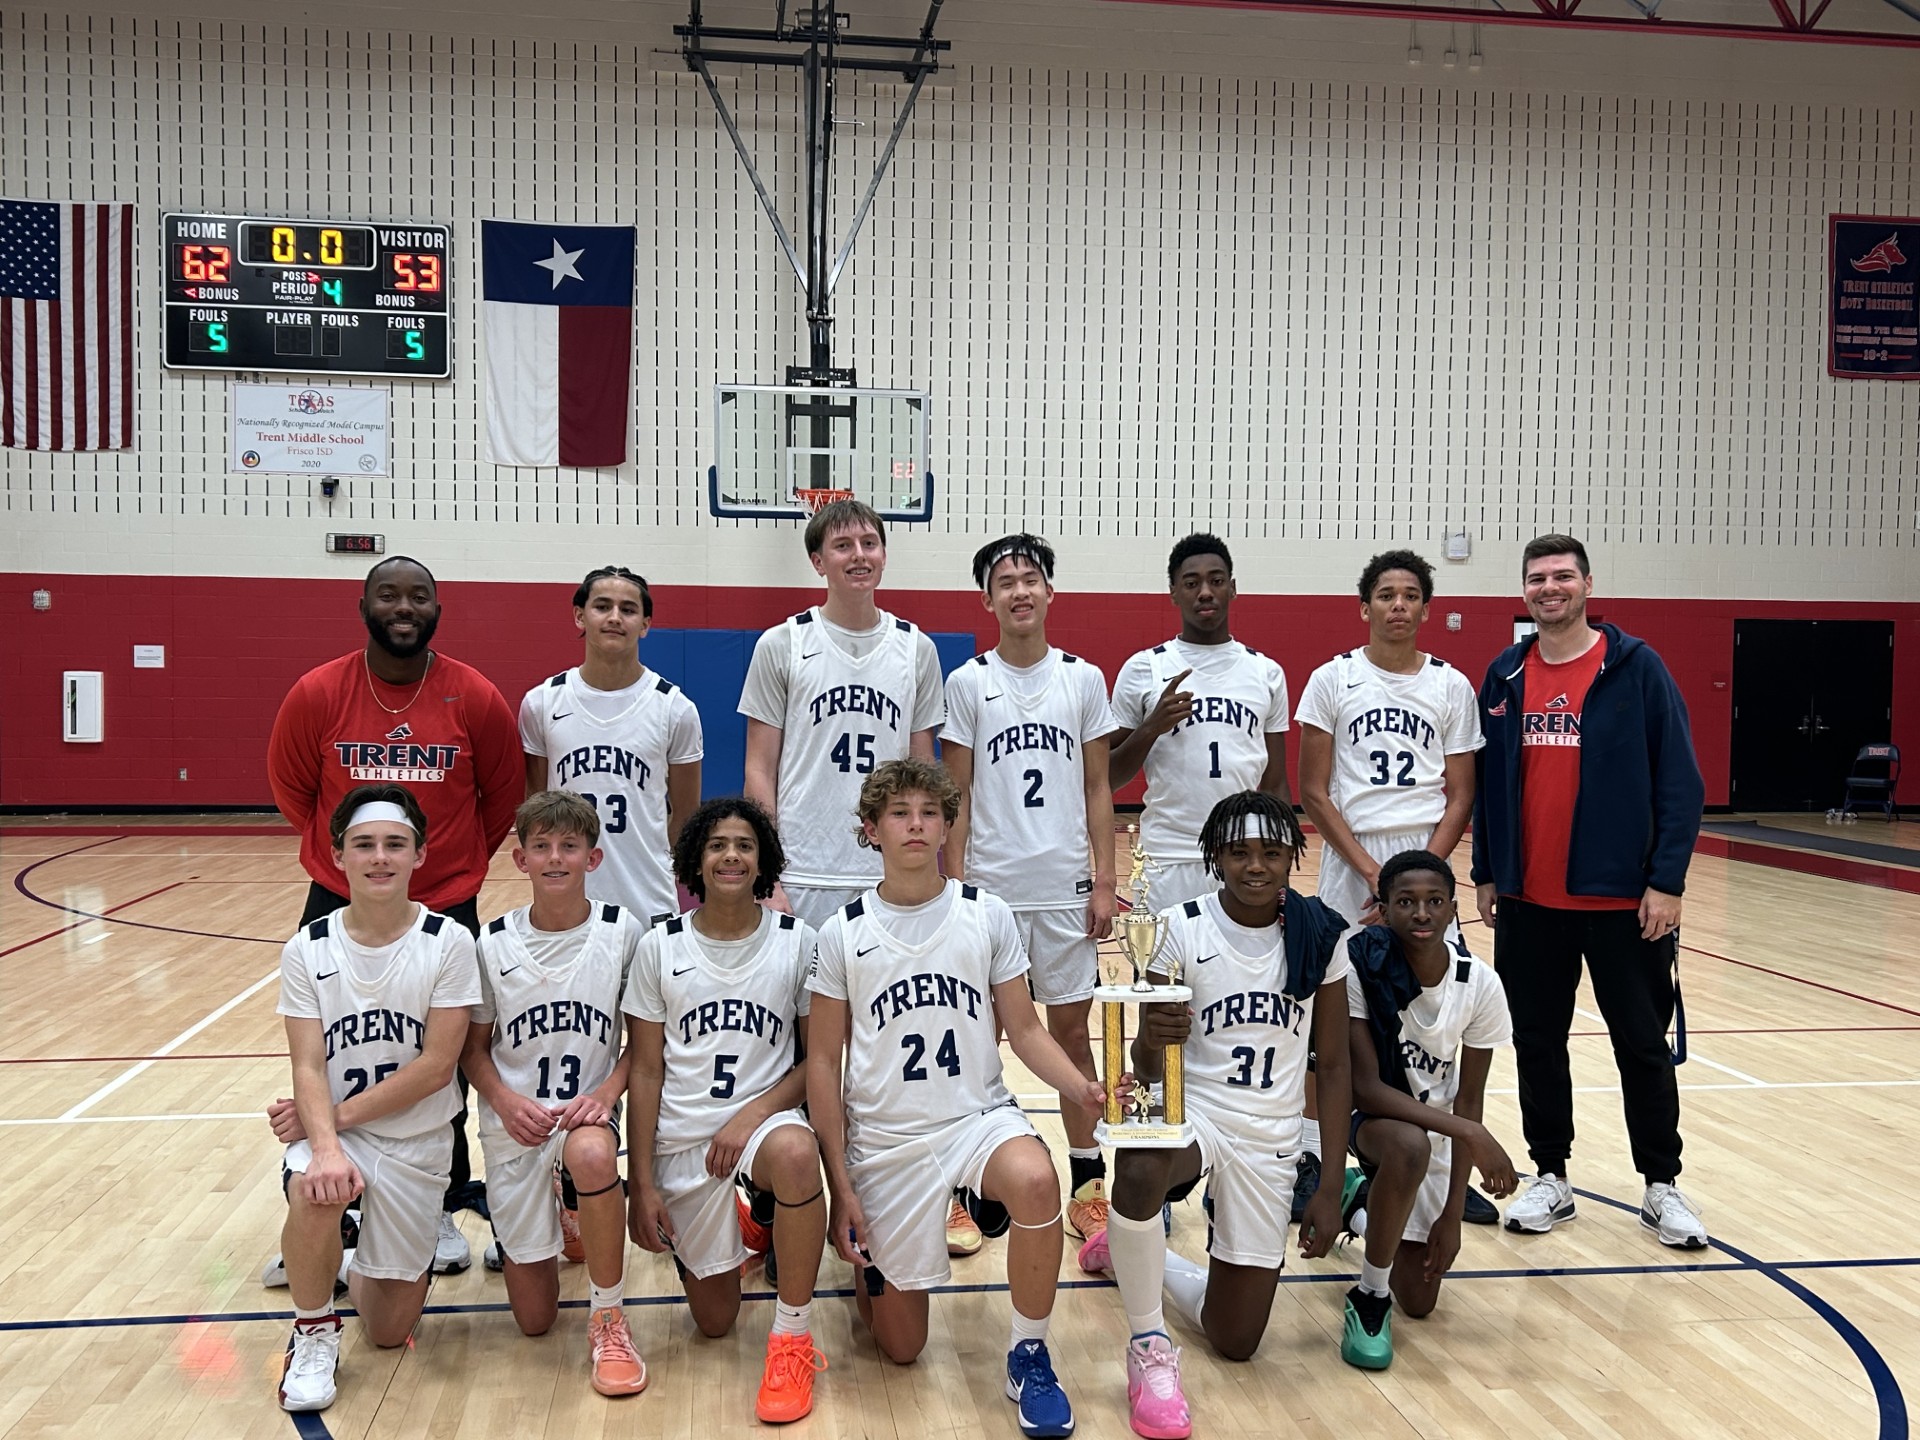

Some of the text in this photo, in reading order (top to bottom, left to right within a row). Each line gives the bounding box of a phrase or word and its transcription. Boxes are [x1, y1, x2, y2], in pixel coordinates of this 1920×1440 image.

[177, 221, 227, 239] HOME
[272, 227, 343, 265] 0.0
[380, 230, 444, 249] VISITOR
[182, 245, 232, 281] 62
[282, 271, 307, 281] POSS
[393, 254, 440, 290] 53
[198, 287, 239, 300] BONUS
[272, 282, 317, 295] PERIOD
[323, 279, 342, 306] 4
[375, 294, 415, 307] BONUS
[1843, 280, 1914, 294] TRENT ATHLETICS
[190, 309, 228, 322] FOULS
[266, 312, 359, 327] PLAYER FOULS
[387, 317, 425, 330] FOULS
[207, 323, 228, 352] 5
[405, 331, 423, 359] 5
[237, 418, 384, 432] Nationally Recognized Model Campus
[256, 432, 364, 445] Trent Middle School
[287, 446, 333, 456] Frisco ISD
[301, 460, 321, 468] 2020
[810, 684, 901, 732] TRENT
[1171, 697, 1259, 738] RENT
[1522, 712, 1582, 735] REN
[987, 723, 1075, 765] TRENT
[1348, 708, 1435, 750] TRENT
[334, 742, 460, 770] TRENT
[557, 745, 651, 791] TRENT
[830, 733, 876, 773] 45
[1209, 741, 1222, 778] 1
[1370, 751, 1416, 786] 32
[352, 769, 443, 781] ATHLETICS
[1023, 769, 1045, 808] 2
[870, 973, 982, 1032] TRENT
[1201, 991, 1305, 1037] TRENT
[324, 1009, 425, 1062] TRENT
[507, 1000, 612, 1049] TRENT
[679, 999, 783, 1047] TRENT
[901, 1028, 961, 1082] 24
[1227, 1046, 1275, 1089] 31
[536, 1054, 581, 1100] 13
[710, 1054, 739, 1099] 5
